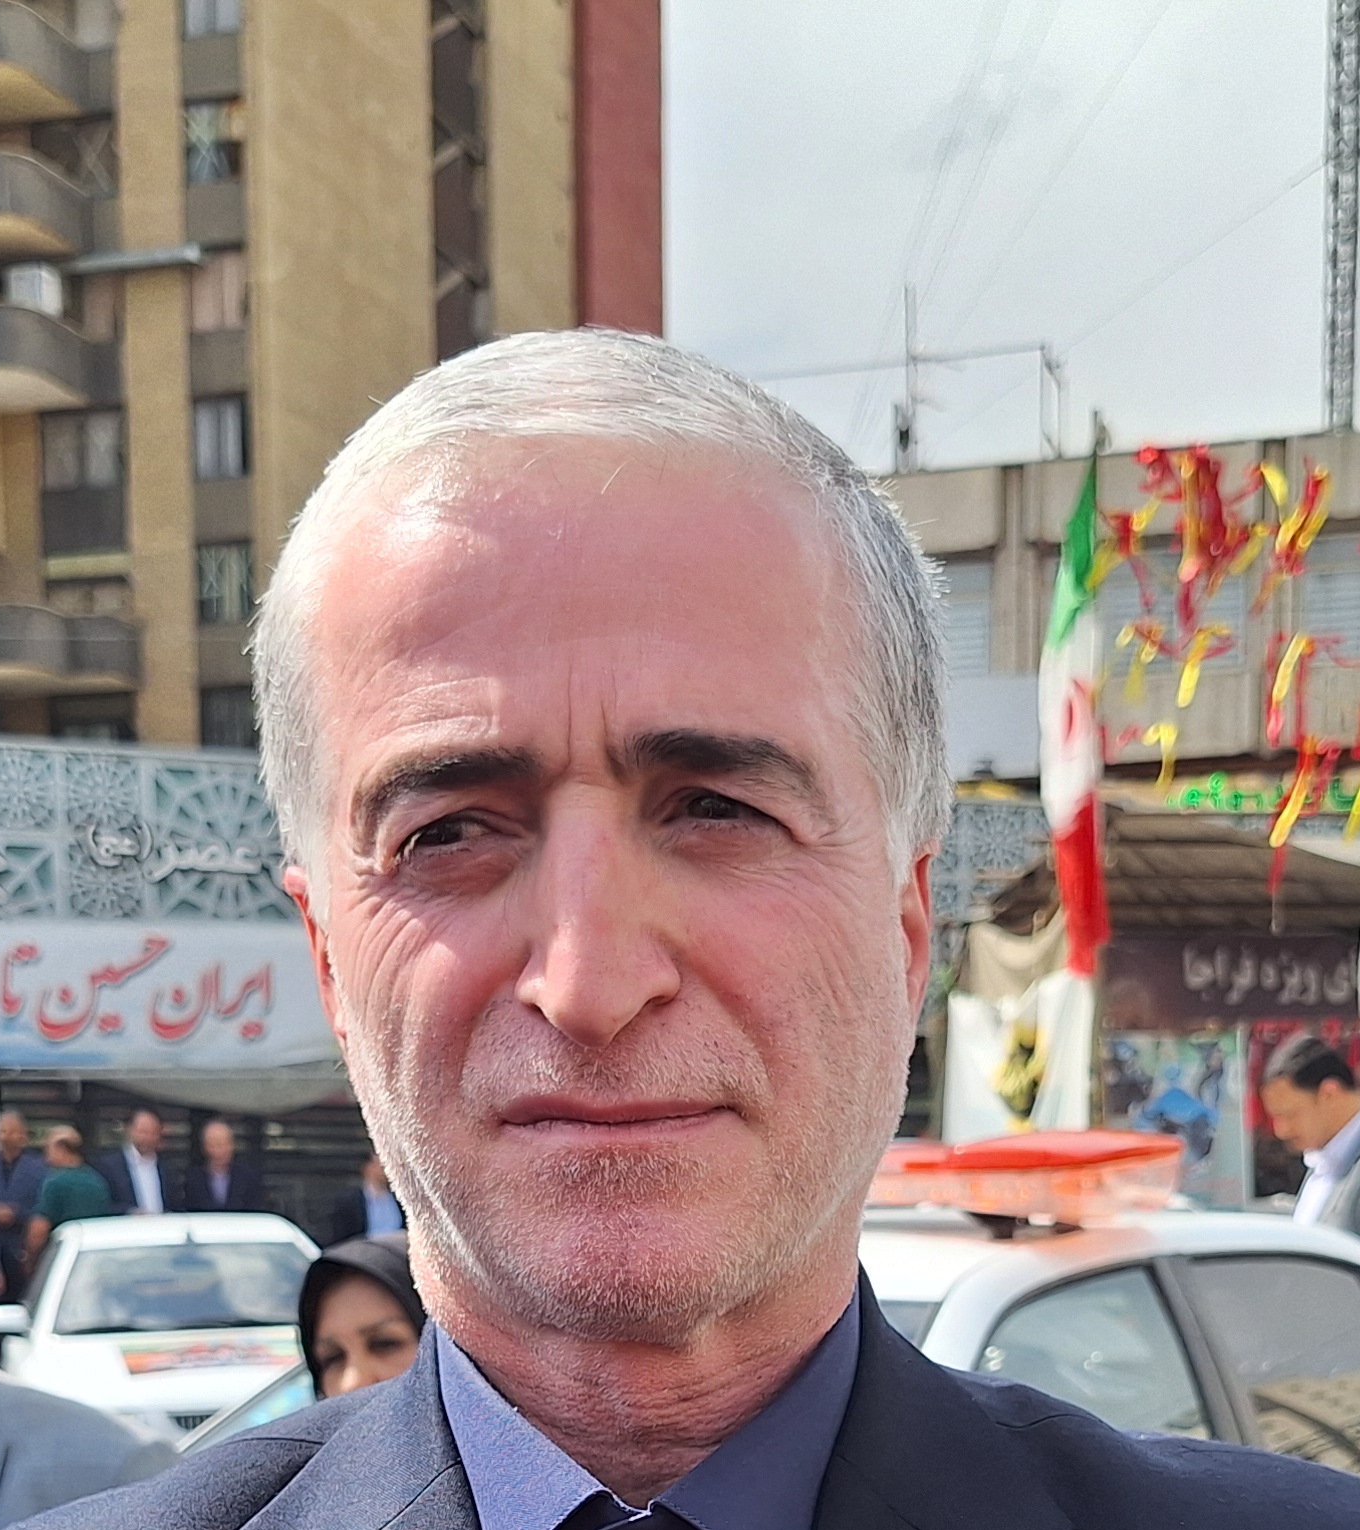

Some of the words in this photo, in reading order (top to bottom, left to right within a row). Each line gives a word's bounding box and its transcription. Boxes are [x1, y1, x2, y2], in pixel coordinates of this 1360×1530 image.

[2, 942, 41, 1017] تا
[37, 936, 173, 1042] حسین
[148, 962, 274, 1042] ایران
